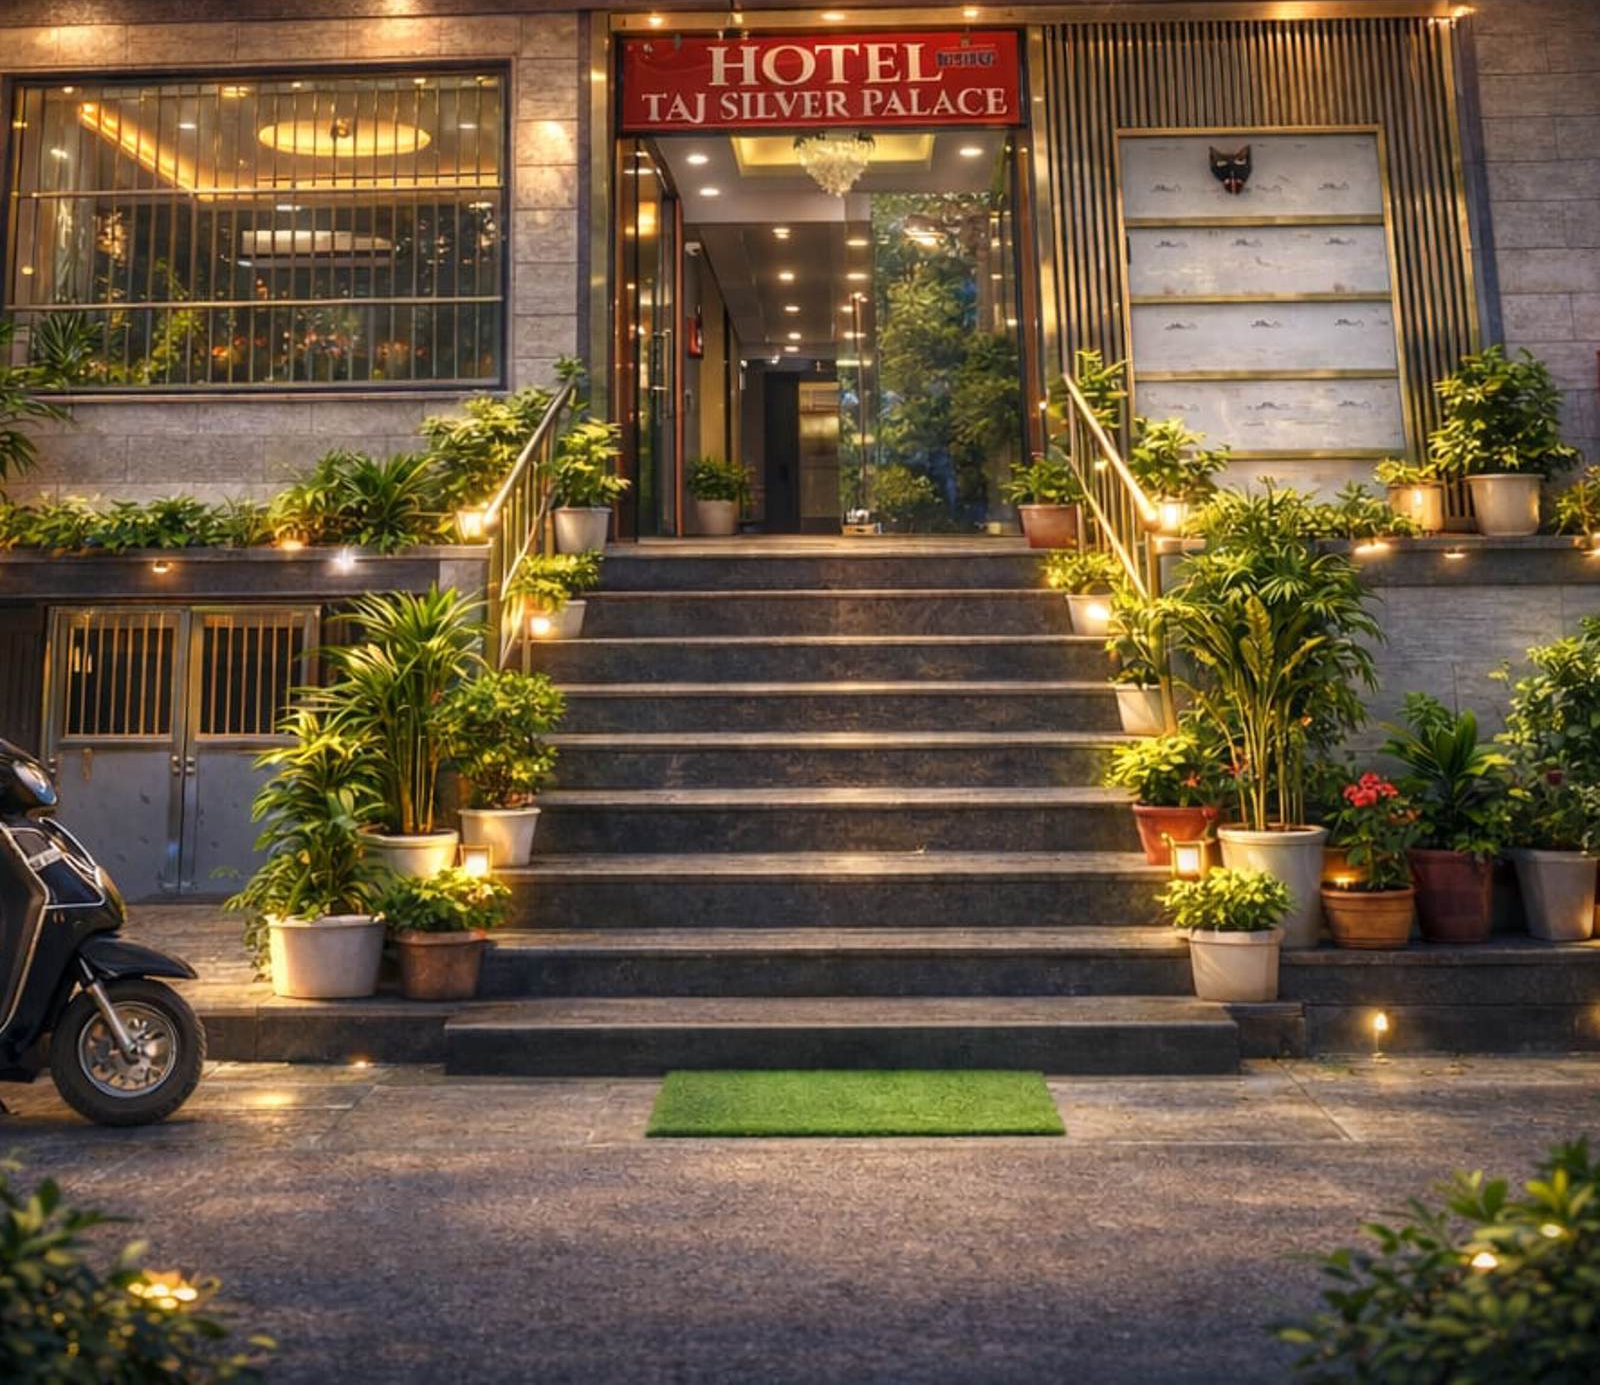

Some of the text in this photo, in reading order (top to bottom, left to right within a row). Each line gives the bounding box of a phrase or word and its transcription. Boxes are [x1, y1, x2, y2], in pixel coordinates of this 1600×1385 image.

[706, 42, 943, 87] HOTEL
[641, 87, 1009, 124] TAJ SILVER PALACE
